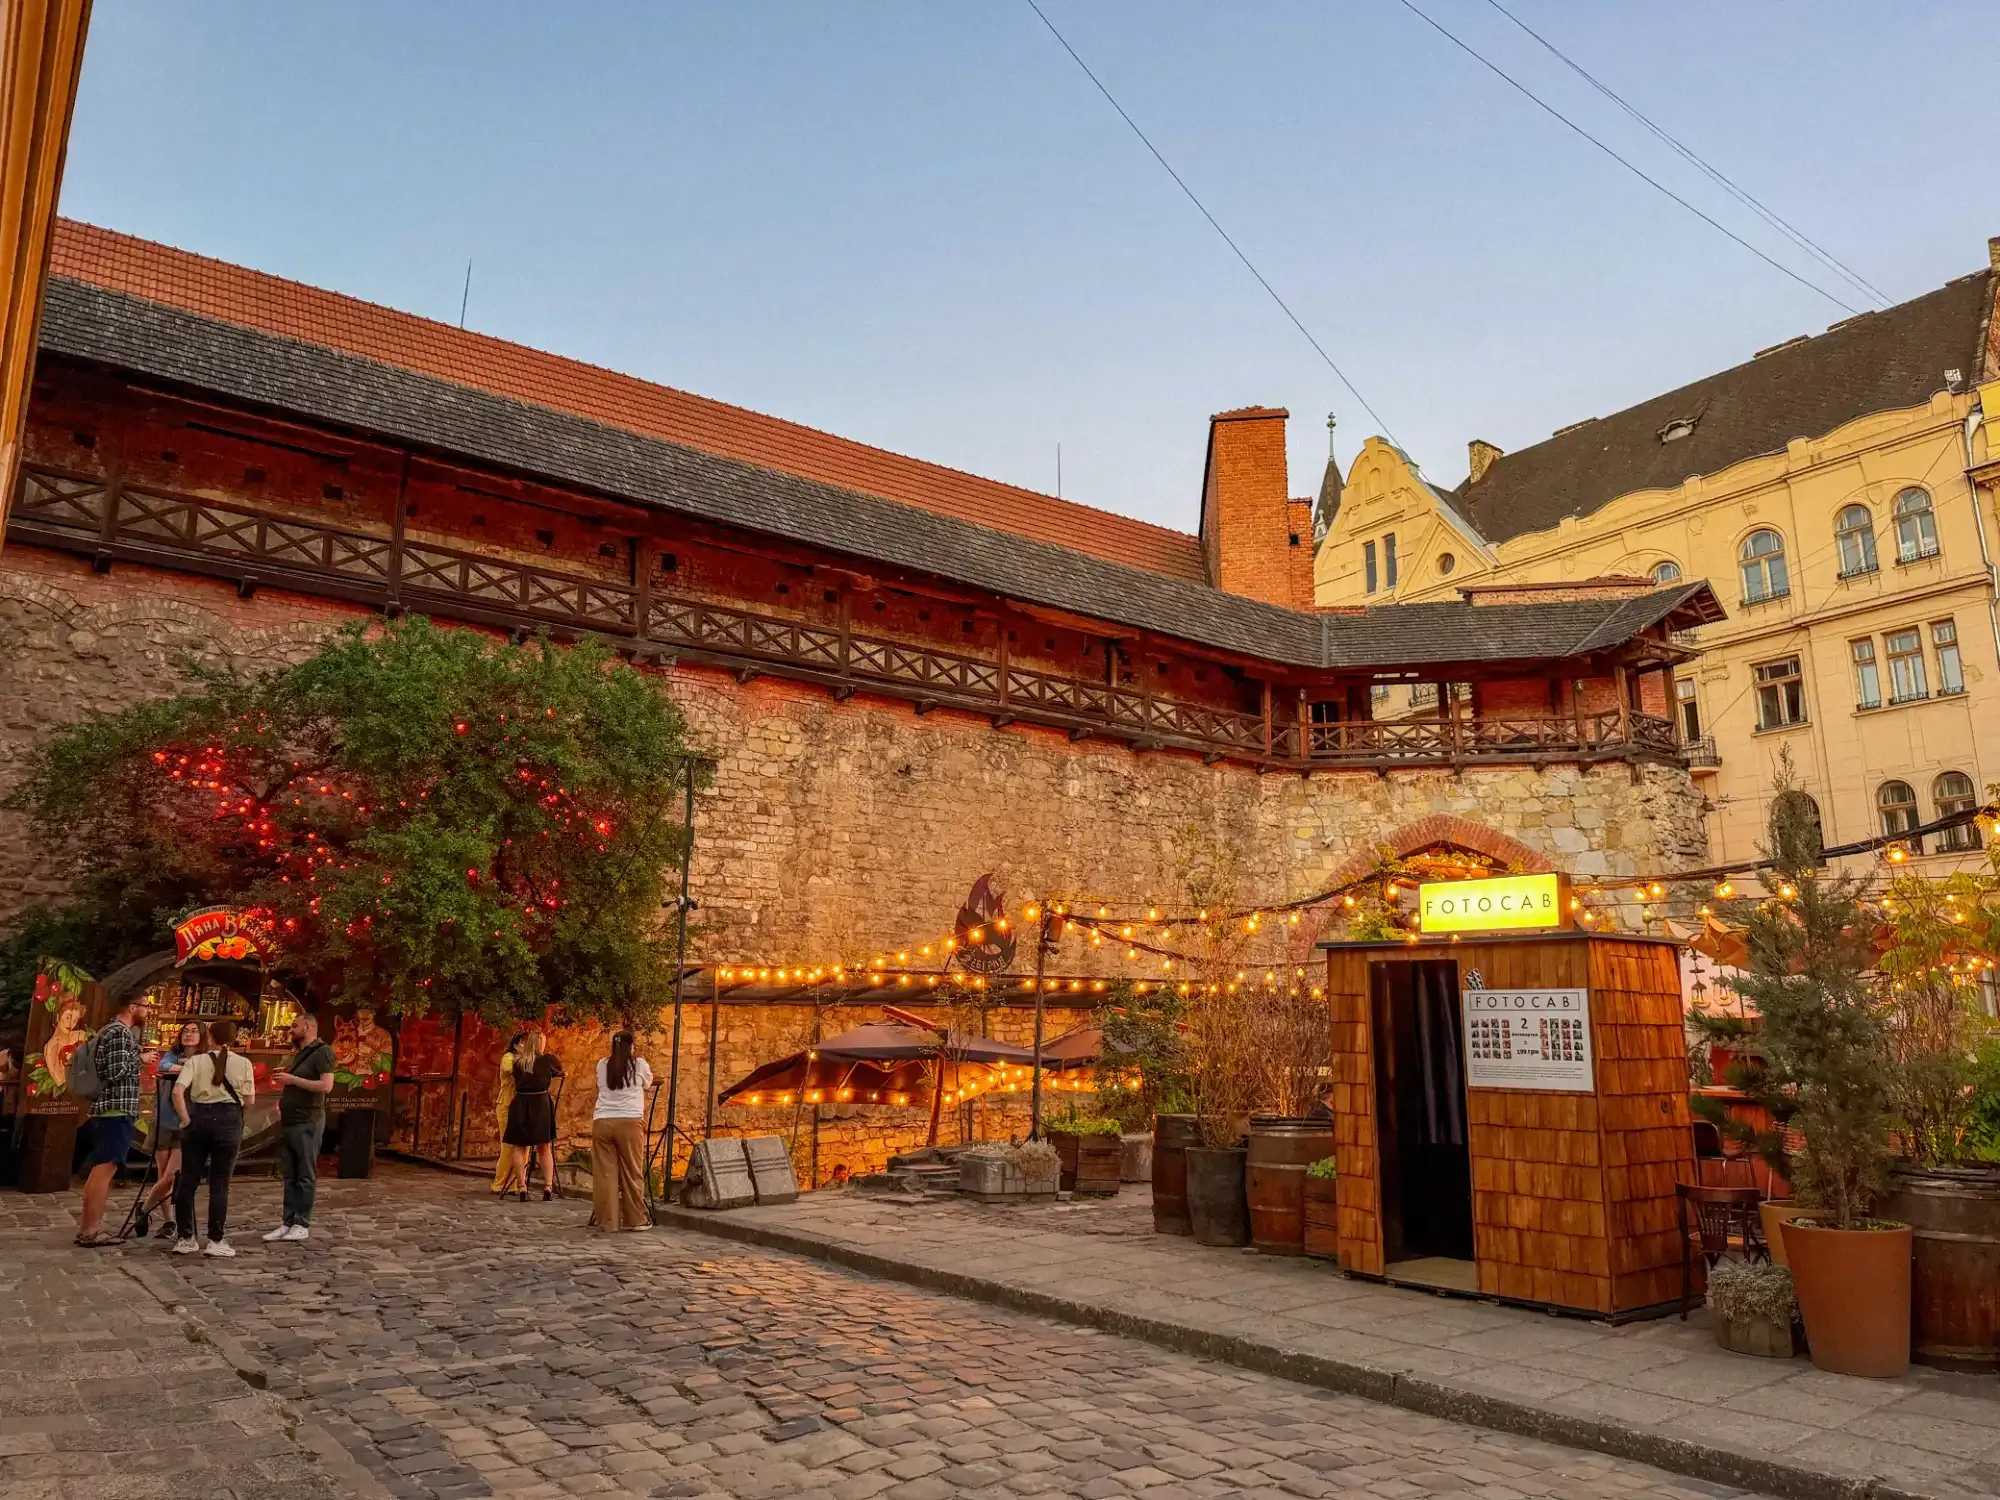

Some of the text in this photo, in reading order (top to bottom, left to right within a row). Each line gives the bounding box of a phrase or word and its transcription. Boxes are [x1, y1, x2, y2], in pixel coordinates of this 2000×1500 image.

[1426, 893, 1551, 915] FOTOCAB
[1475, 996, 1570, 1008] FOTOCAB
[1521, 1017, 1528, 1029] 2
